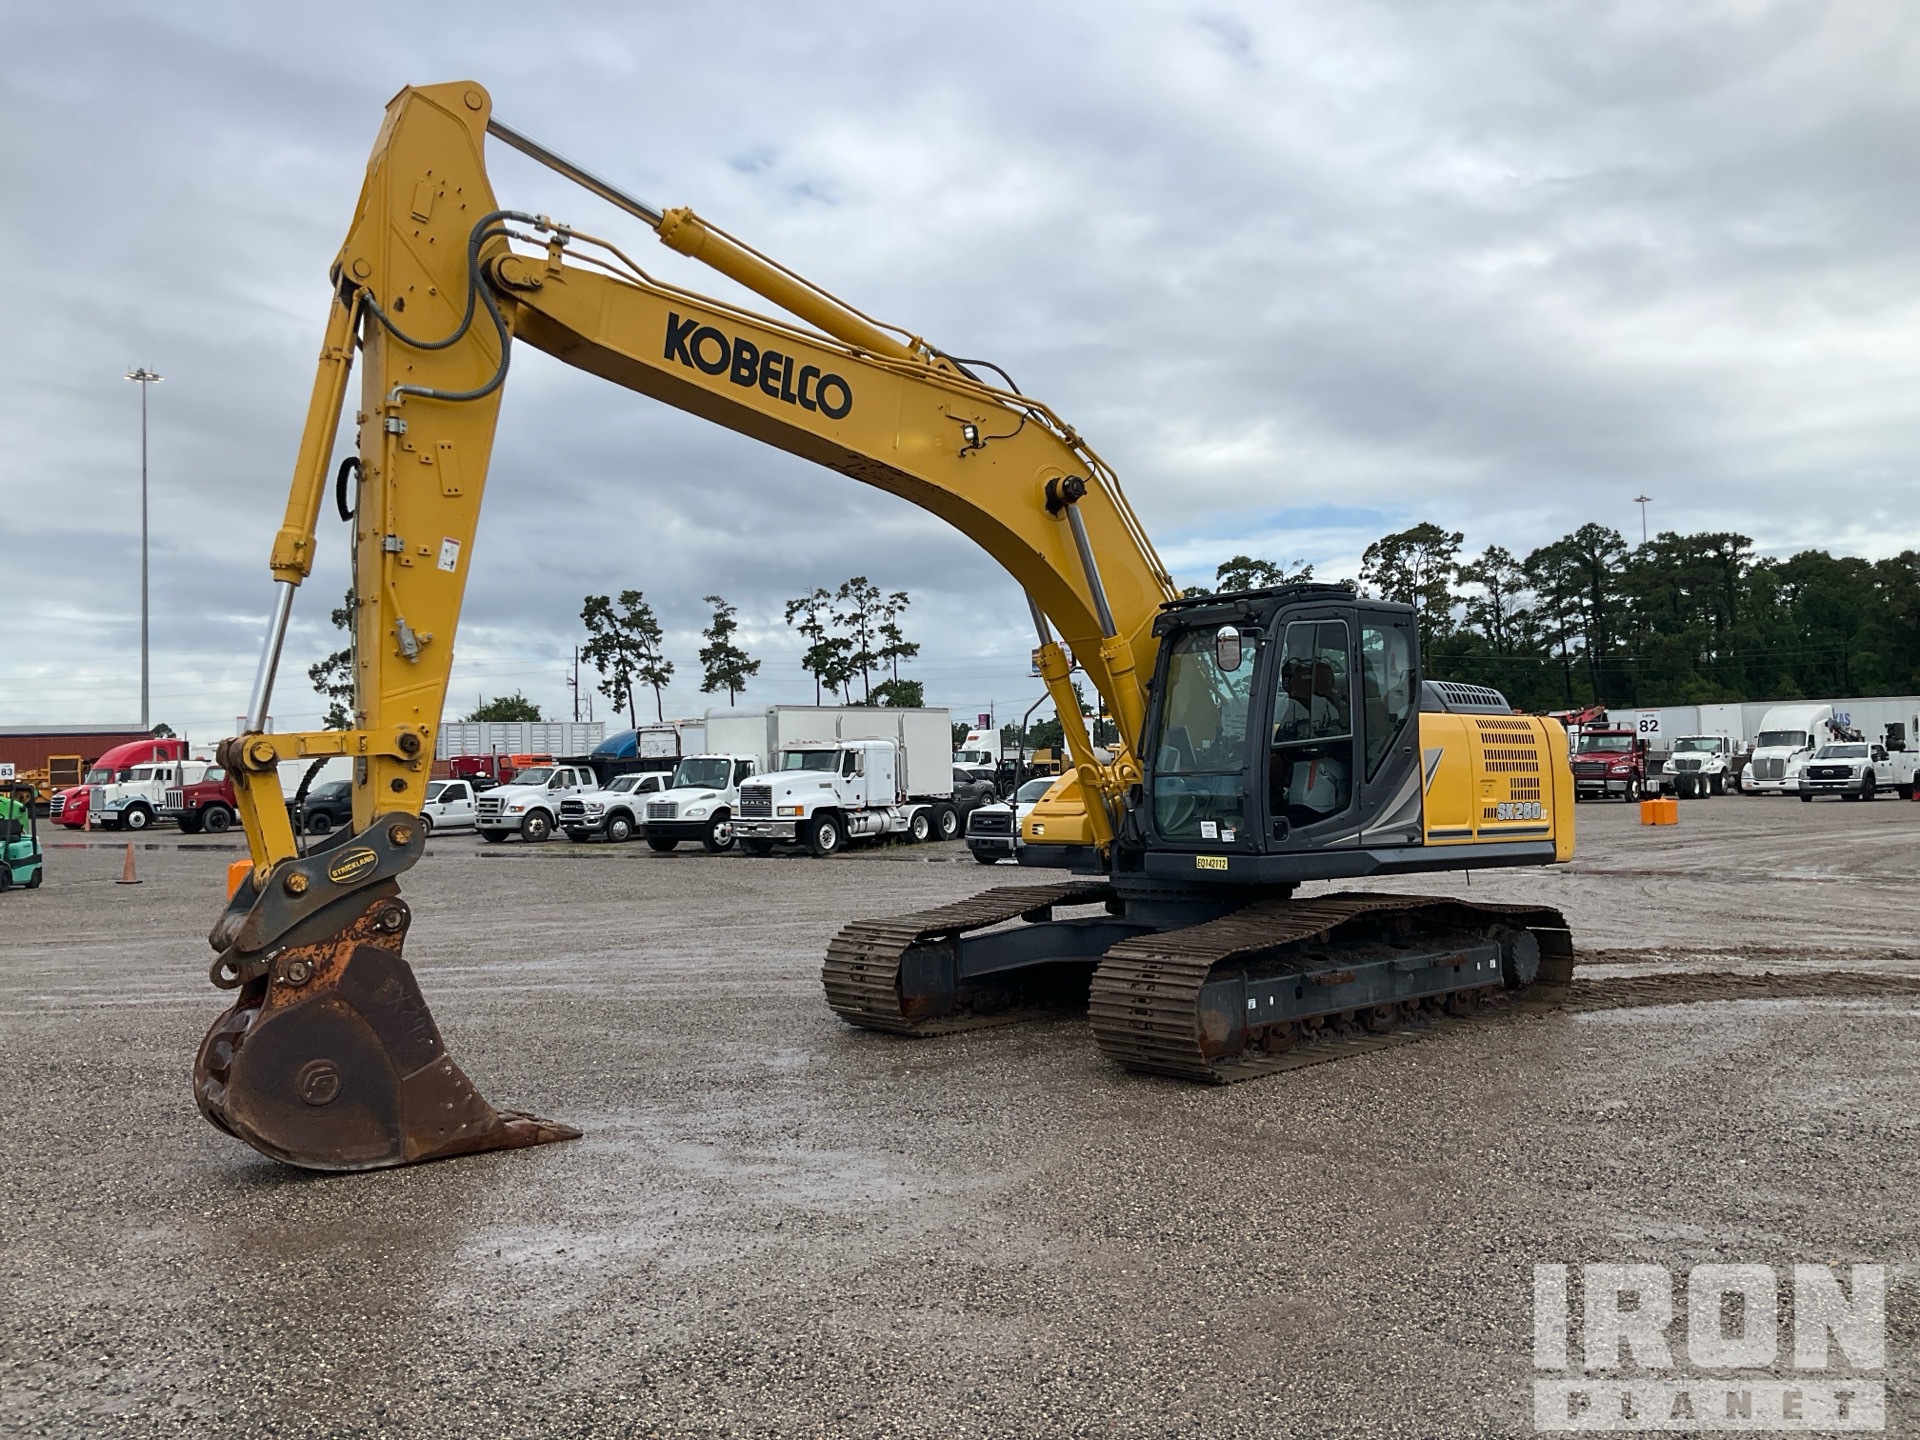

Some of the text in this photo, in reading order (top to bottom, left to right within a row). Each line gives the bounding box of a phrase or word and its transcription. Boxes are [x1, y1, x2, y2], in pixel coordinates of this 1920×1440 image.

[664, 311, 852, 419] KOBELCO
[1640, 719, 1659, 732] 82
[1, 768, 13, 776] 83
[1497, 802, 1541, 820] SK260
[332, 855, 375, 877] STRICKLAND
[1197, 859, 1227, 869] EQ142112
